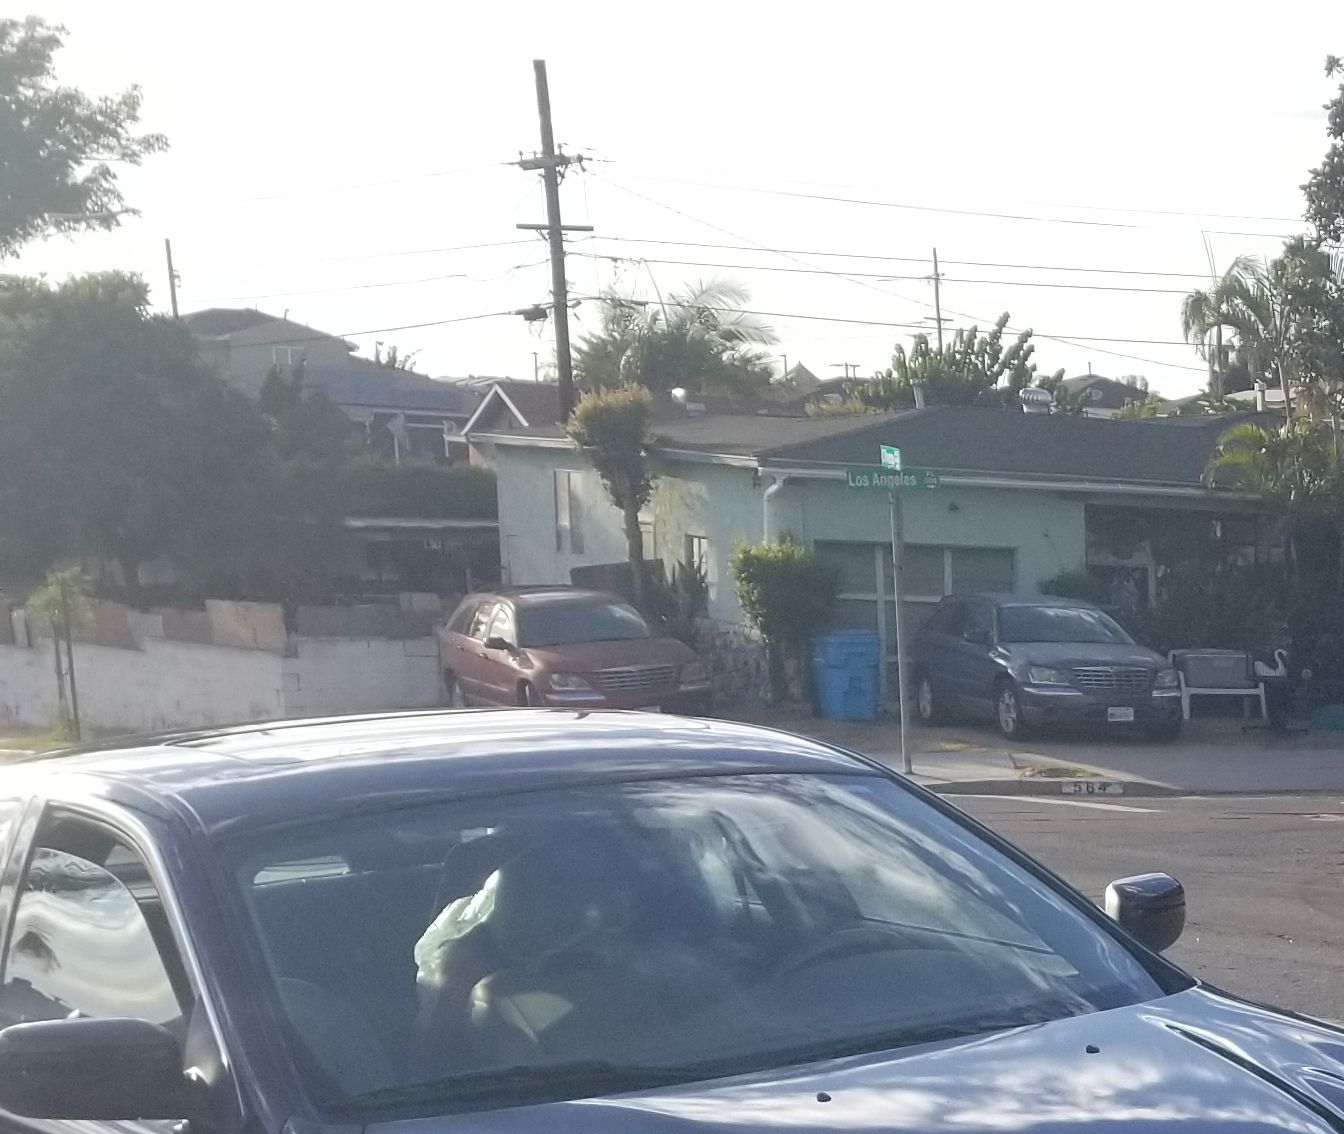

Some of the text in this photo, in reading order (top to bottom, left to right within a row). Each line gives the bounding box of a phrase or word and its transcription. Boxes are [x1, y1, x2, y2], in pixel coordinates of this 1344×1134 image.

[848, 471, 869, 487] Los
[872, 470, 917, 489] Angeles
[1073, 781, 1109, 795] 564
